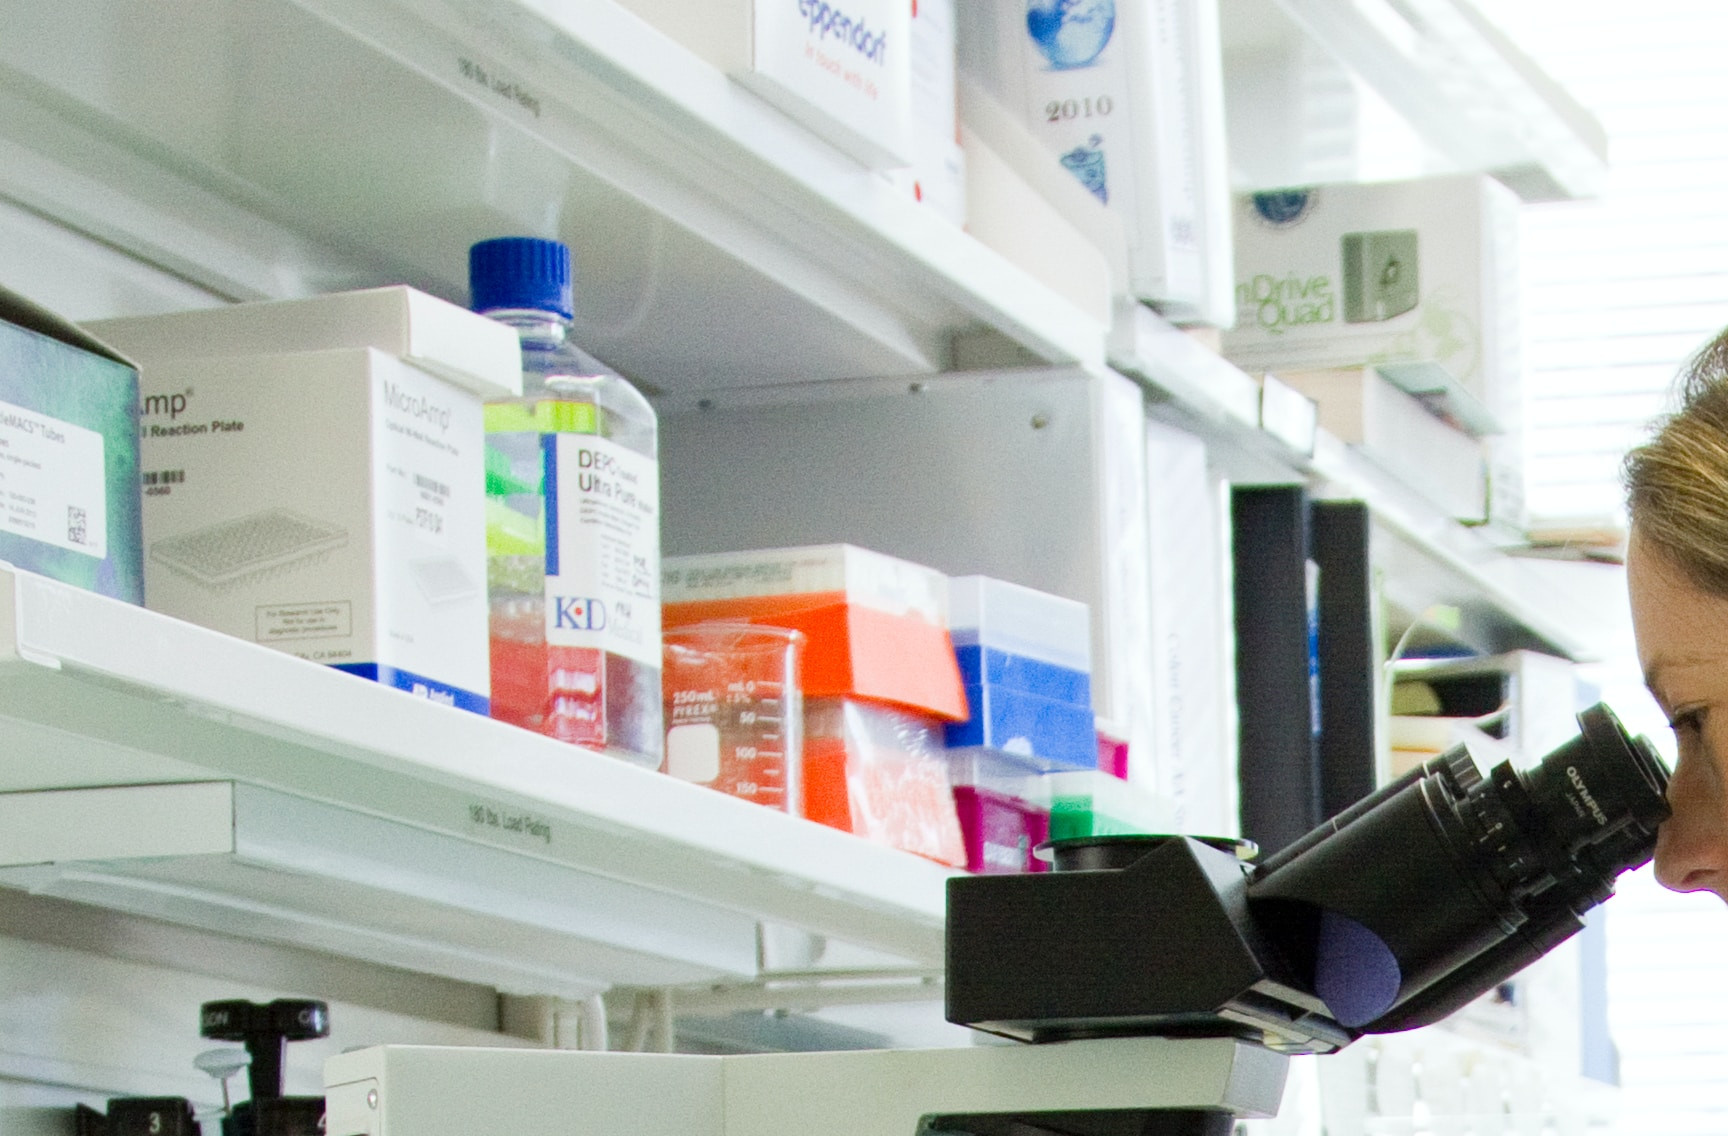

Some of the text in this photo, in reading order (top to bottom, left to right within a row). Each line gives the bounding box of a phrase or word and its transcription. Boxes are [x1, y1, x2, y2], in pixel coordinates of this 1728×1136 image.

[1045, 95, 1114, 123] 2010
[1256, 292, 1334, 335] Quad
[40, 422, 66, 445] Tubes
[150, 424, 208, 438] Reaction
[211, 420, 245, 433] Plate
[578, 473, 611, 498] Ultra
[740, 711, 756, 724] 50
[735, 746, 757, 759] 100
[736, 782, 758, 795] 150
[1566, 765, 1608, 826] OLYMPUS
[149, 1111, 161, 1134] 3
